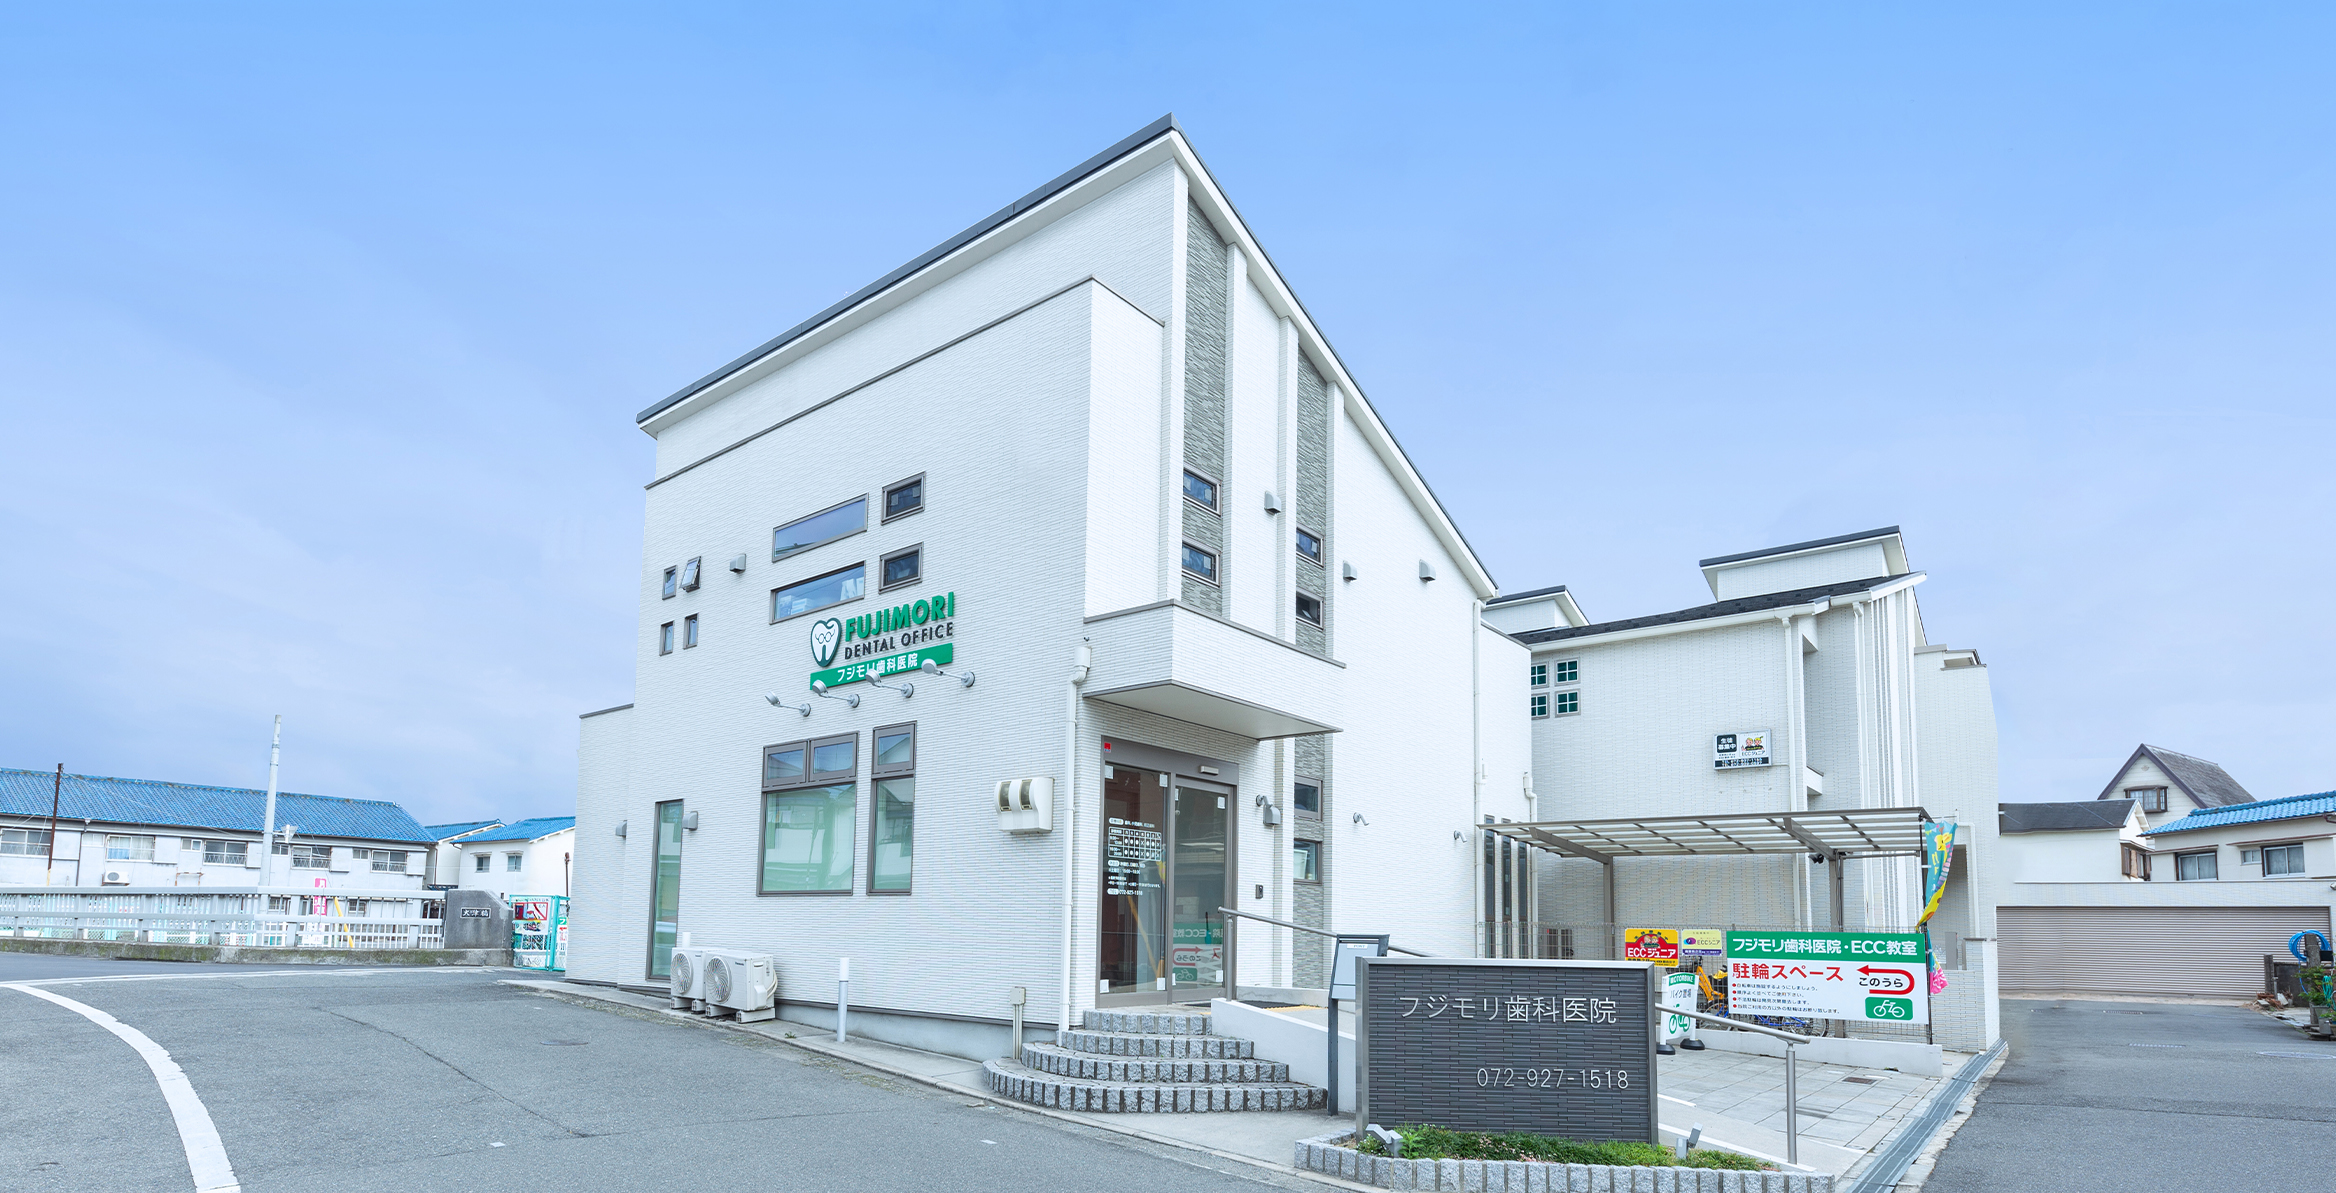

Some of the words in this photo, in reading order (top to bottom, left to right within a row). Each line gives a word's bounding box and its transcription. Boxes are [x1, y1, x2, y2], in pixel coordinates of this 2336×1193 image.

[845, 591, 954, 642] FUJIMORI
[844, 636, 896, 660] DENTAL
[900, 622, 954, 646] OFFICE
[837, 652, 918, 683] フジモリ歯科医院
[1732, 938, 1918, 957] フジモリ歯科医院・ECC教室
[1732, 962, 1844, 982] 駐輪スペース
[1858, 976, 1904, 988] このうら
[1399, 994, 1617, 1025] フジモリ歯科医院
[1476, 1067, 1630, 1090] 072-927-1518
